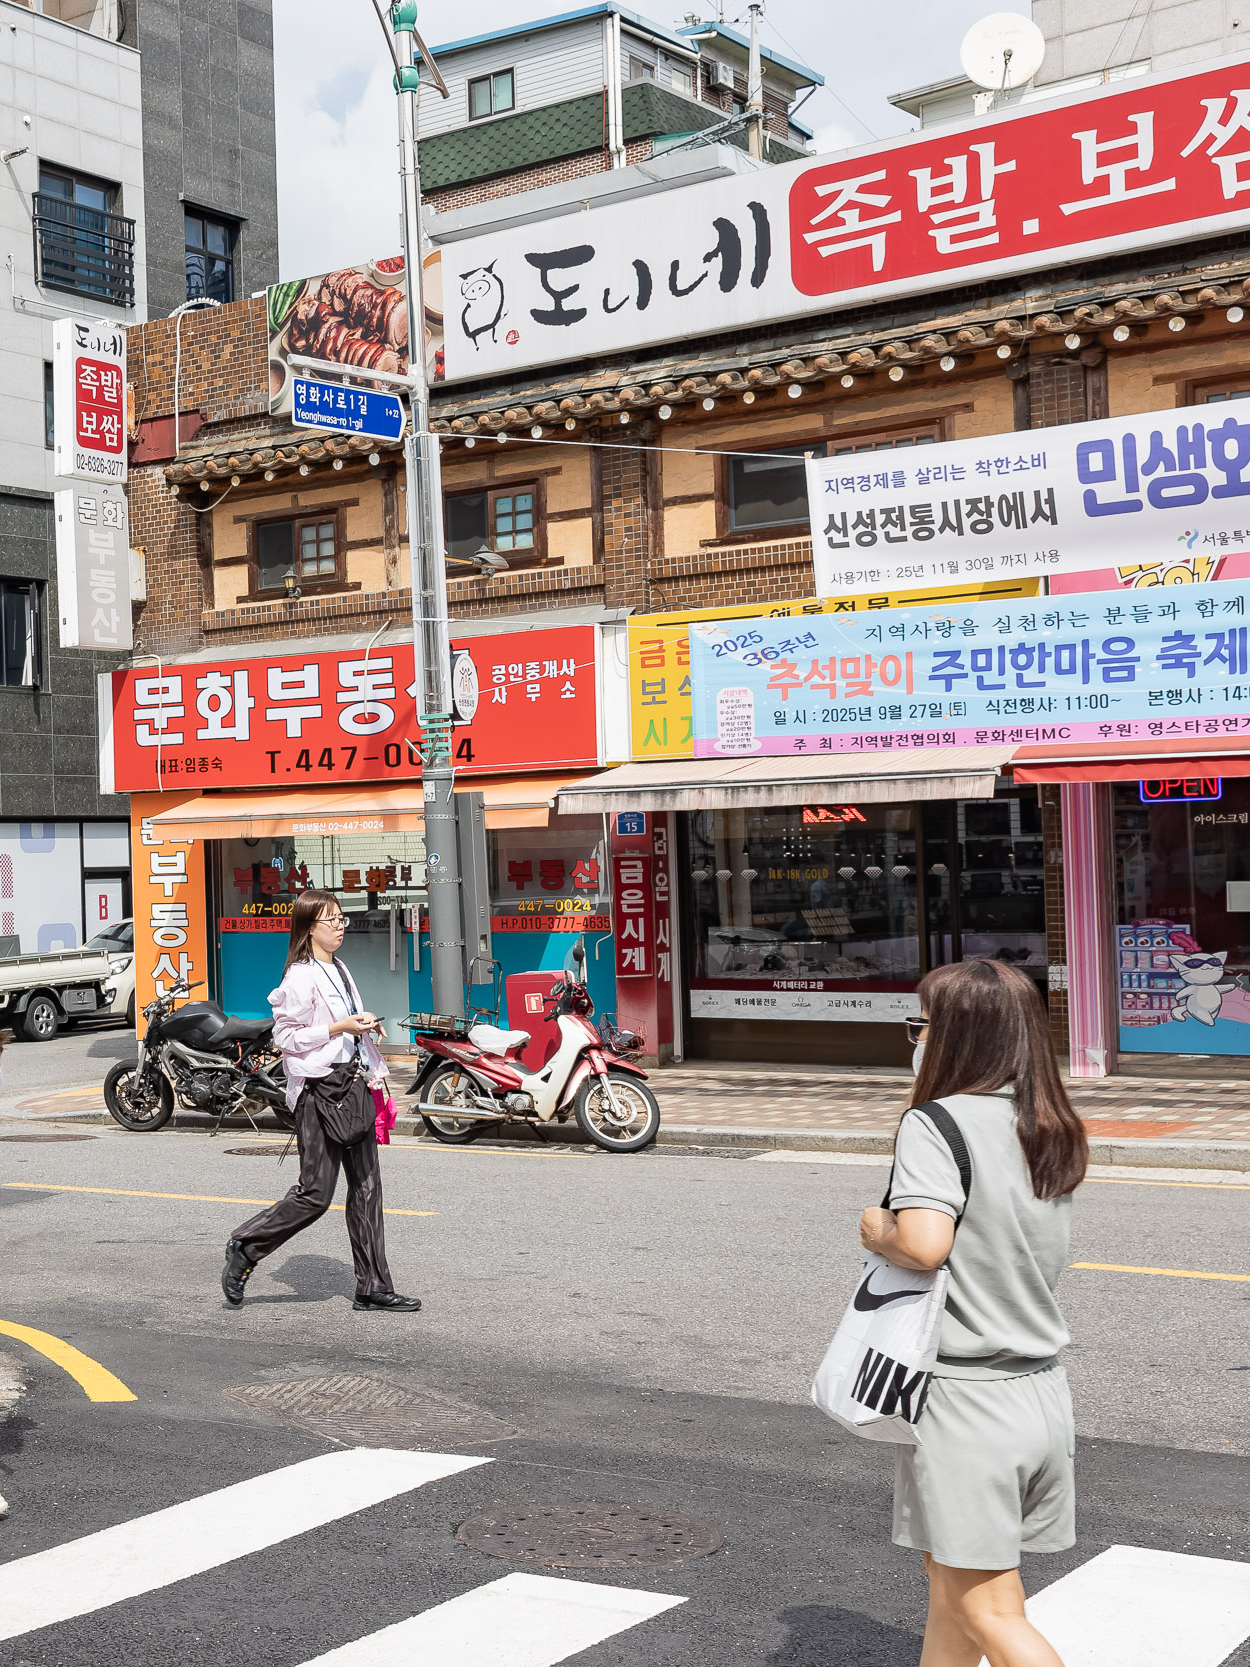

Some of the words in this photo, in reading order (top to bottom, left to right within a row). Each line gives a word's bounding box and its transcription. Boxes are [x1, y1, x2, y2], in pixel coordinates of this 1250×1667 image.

[78, 364, 121, 403] 족발
[79, 411, 121, 447] 보쌈
[296, 407, 347, 427] Yeonghwasa-ro
[76, 453, 124, 477] 02-6326-3277
[824, 469, 908, 495] 지역경제를
[915, 462, 968, 486] 살리는
[975, 451, 1048, 478] 착한소비
[77, 495, 124, 531] 문화
[823, 487, 1059, 549] 신성전통시장에서
[1202, 529, 1250, 546] 서울특
[830, 567, 881, 586] 사용기한
[896, 562, 925, 580] 25년
[930, 560, 960, 575] 11월
[964, 555, 995, 572] 30일
[1000, 552, 1027, 569] 까지
[1033, 549, 1061, 565] 사용
[88, 528, 121, 644] 부동산
[864, 617, 980, 643] 지역사랑을
[992, 610, 1090, 634] 실천하는
[1103, 601, 1181, 625] 분들과
[1195, 595, 1245, 619] 함께
[711, 629, 764, 658] 2025
[742, 631, 819, 667] 36주년
[491, 658, 576, 684] 공인중개사
[766, 651, 914, 701] 추석맞이
[928, 636, 1141, 693] 주민한마음
[1156, 626, 1248, 679] 축제
[133, 649, 478, 748] 문화부동
[821, 707, 871, 723] 2025년
[878, 704, 902, 720] 9월
[908, 702, 943, 719] 27일
[949, 701, 967, 717] (토)
[1222, 685, 1250, 702] 14:
[850, 731, 956, 749] 지역발전협의회
[974, 727, 1071, 744] 문화센터MC
[265, 738, 476, 775] T.447-004
[1143, 778, 1218, 798] OPEN
[292, 821, 327, 833] 문화부동산
[328, 820, 385, 831] 02-447-0024
[625, 822, 638, 832] 15
[1194, 812, 1249, 825] 아이스크림
[233, 865, 310, 894] 부동산
[342, 868, 388, 893] 문화
[507, 858, 601, 891] 부동산
[805, 868, 829, 879] GOLD
[242, 903, 294, 915] 447-002
[518, 898, 592, 912] 447-0024
[620, 860, 646, 971] 금은시계
[149, 851, 194, 999] 부동산
[501, 916, 611, 930] H.P.010-3777-4635
[827, 999, 872, 1009] 고급시계수리
